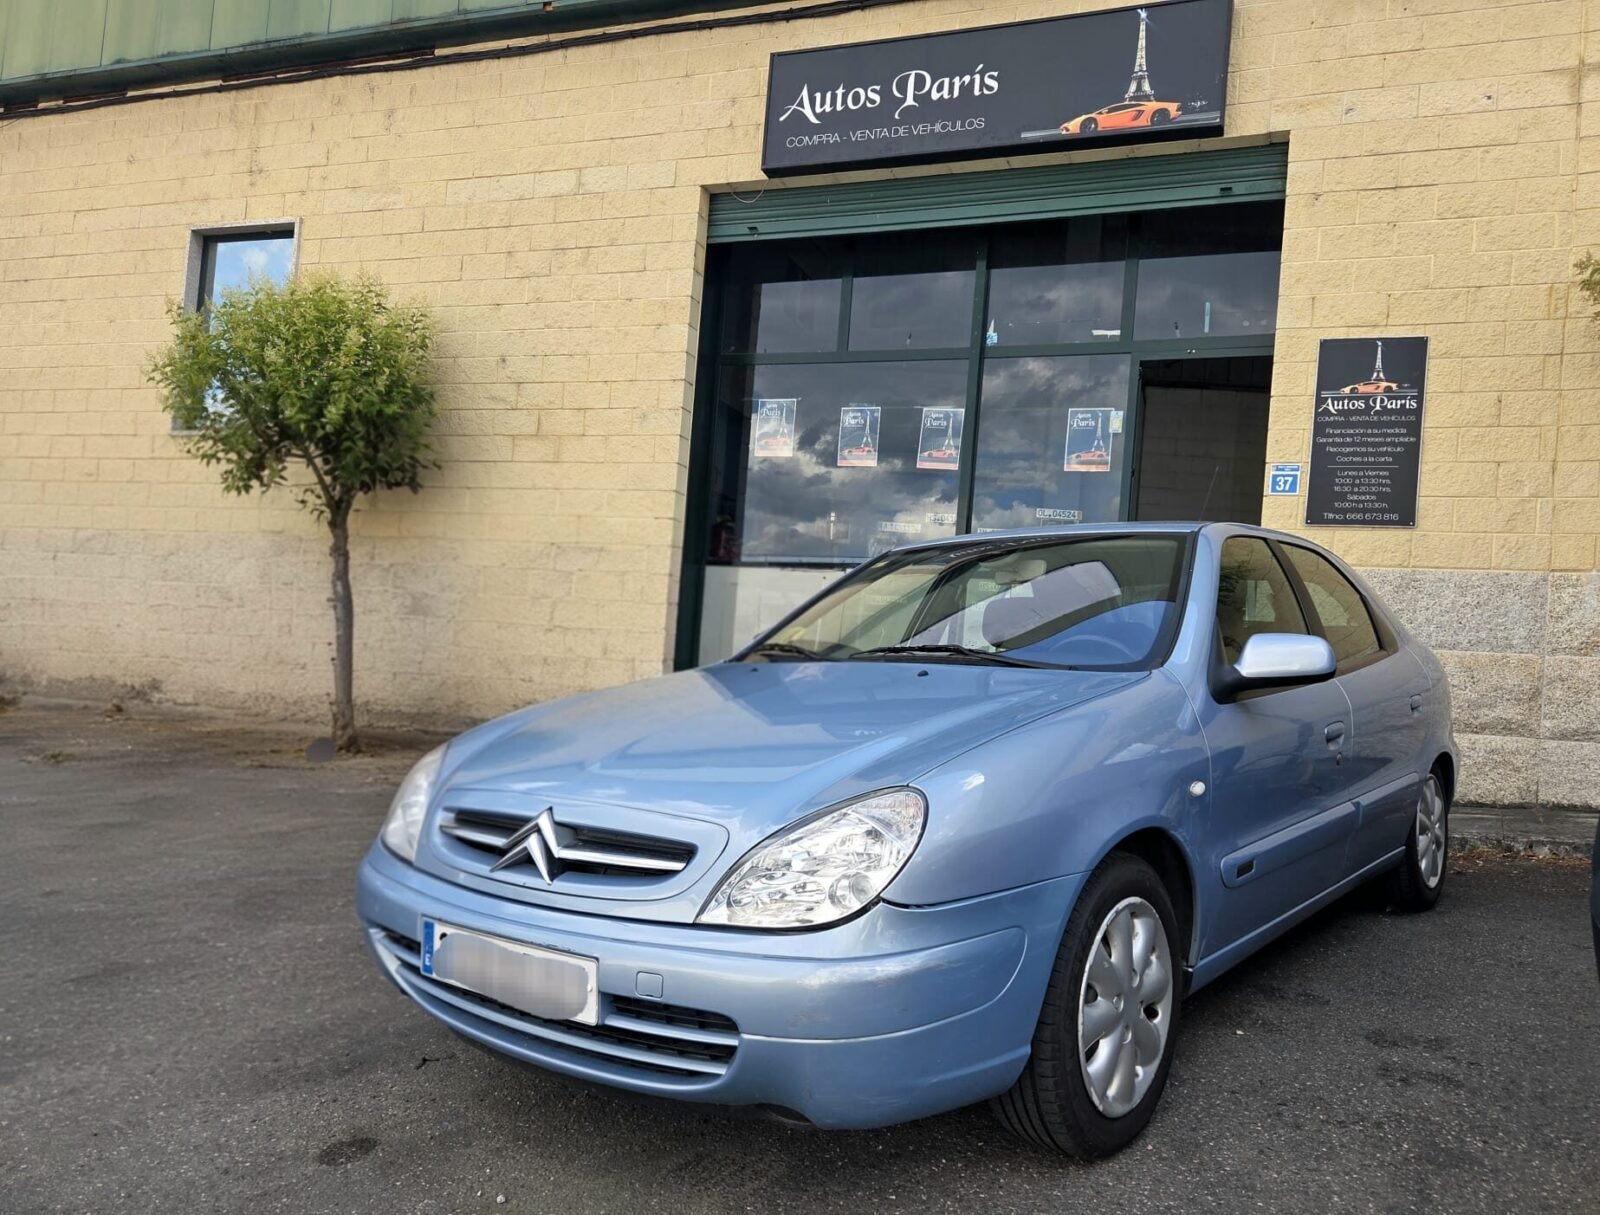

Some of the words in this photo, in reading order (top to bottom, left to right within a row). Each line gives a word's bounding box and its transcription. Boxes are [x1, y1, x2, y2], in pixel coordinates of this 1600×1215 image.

[778, 82, 882, 124] Autos
[892, 63, 1000, 120] París
[786, 131, 841, 148] COMPRA
[849, 128, 890, 142] VENTA
[891, 125, 910, 138] DE
[911, 117, 986, 137] VEHÍCULOS
[1318, 397, 1366, 415] Autos
[1369, 395, 1418, 415] París
[1275, 476, 1293, 491] 37
[1383, 513, 1400, 521] 816
